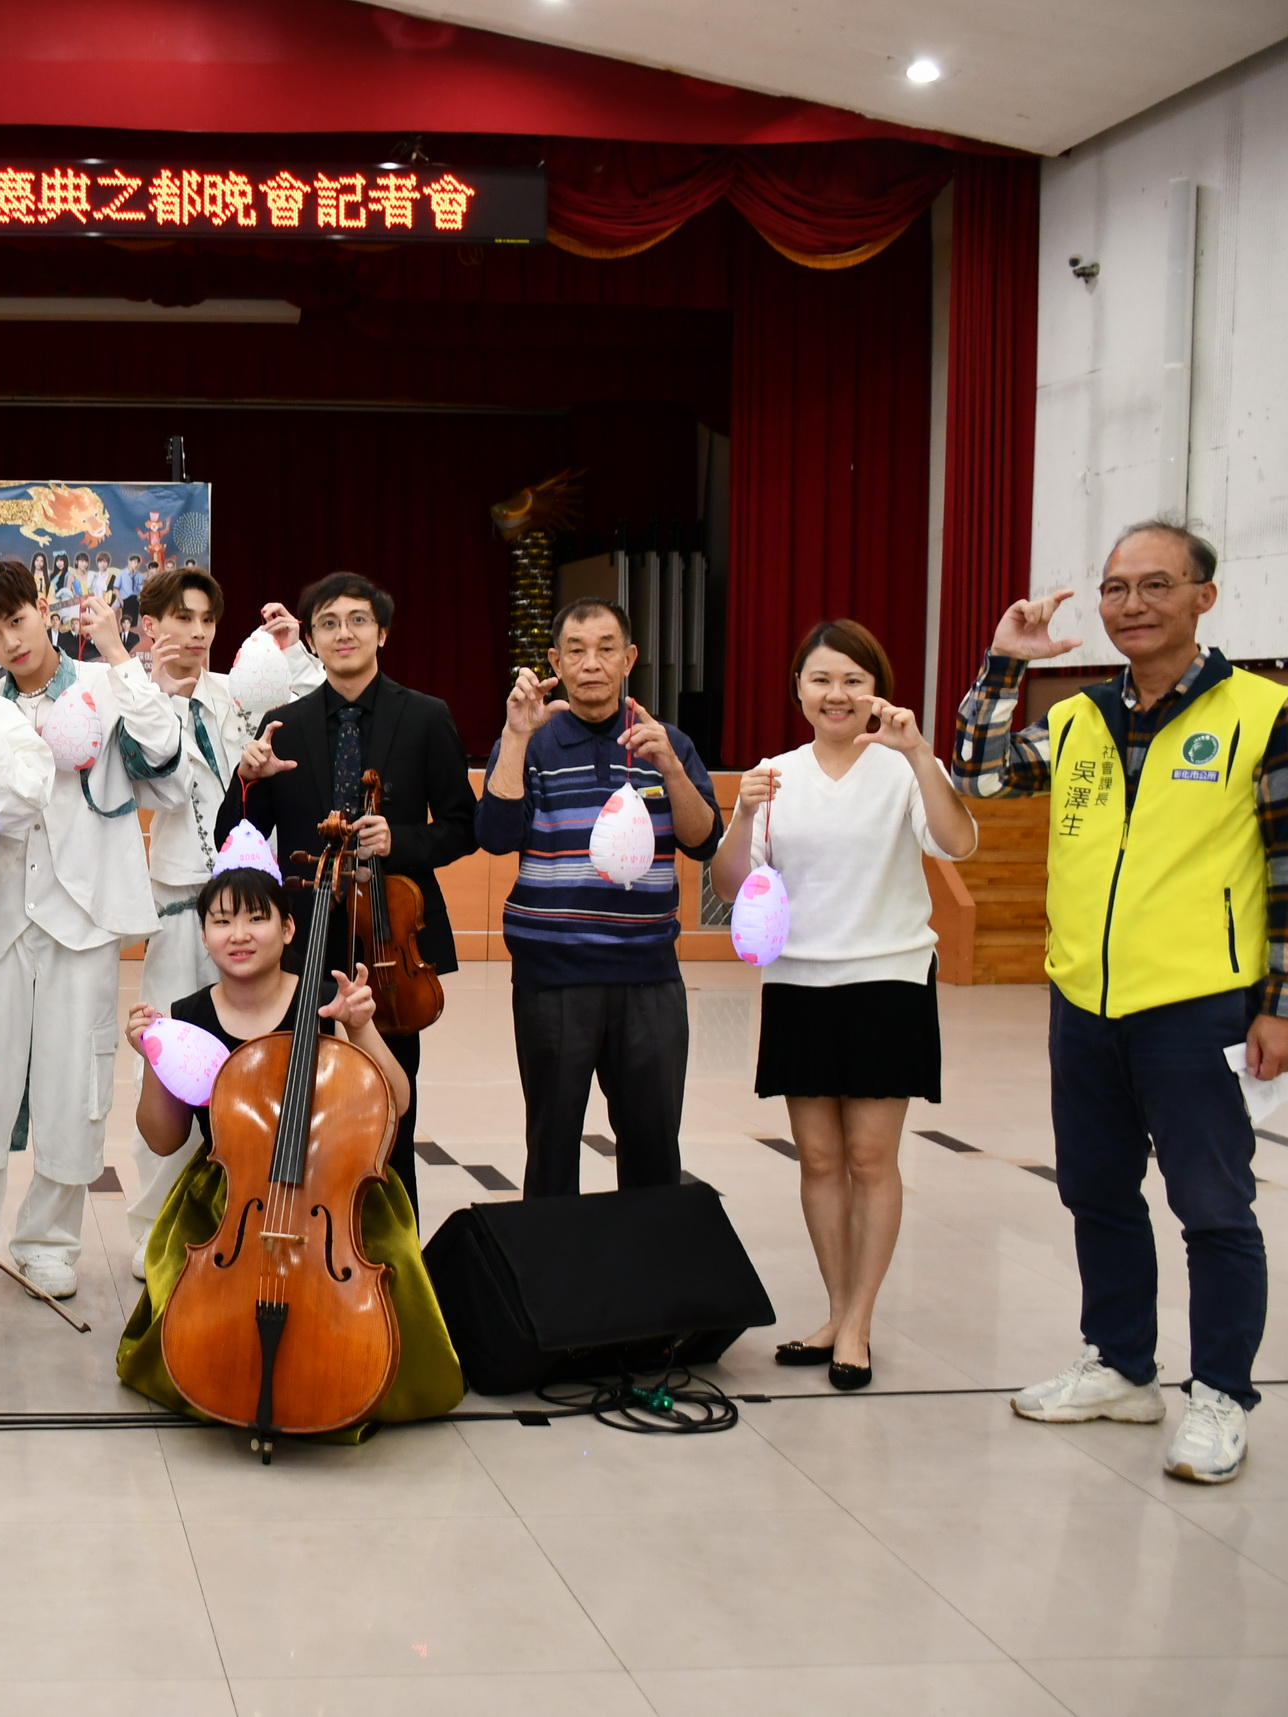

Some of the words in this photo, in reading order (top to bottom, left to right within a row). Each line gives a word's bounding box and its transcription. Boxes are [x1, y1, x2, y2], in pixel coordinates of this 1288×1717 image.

[1059, 761, 1096, 837] 吳澤生
[1094, 744, 1117, 807] 社會課長
[1173, 769, 1218, 781] 彰化市公所
